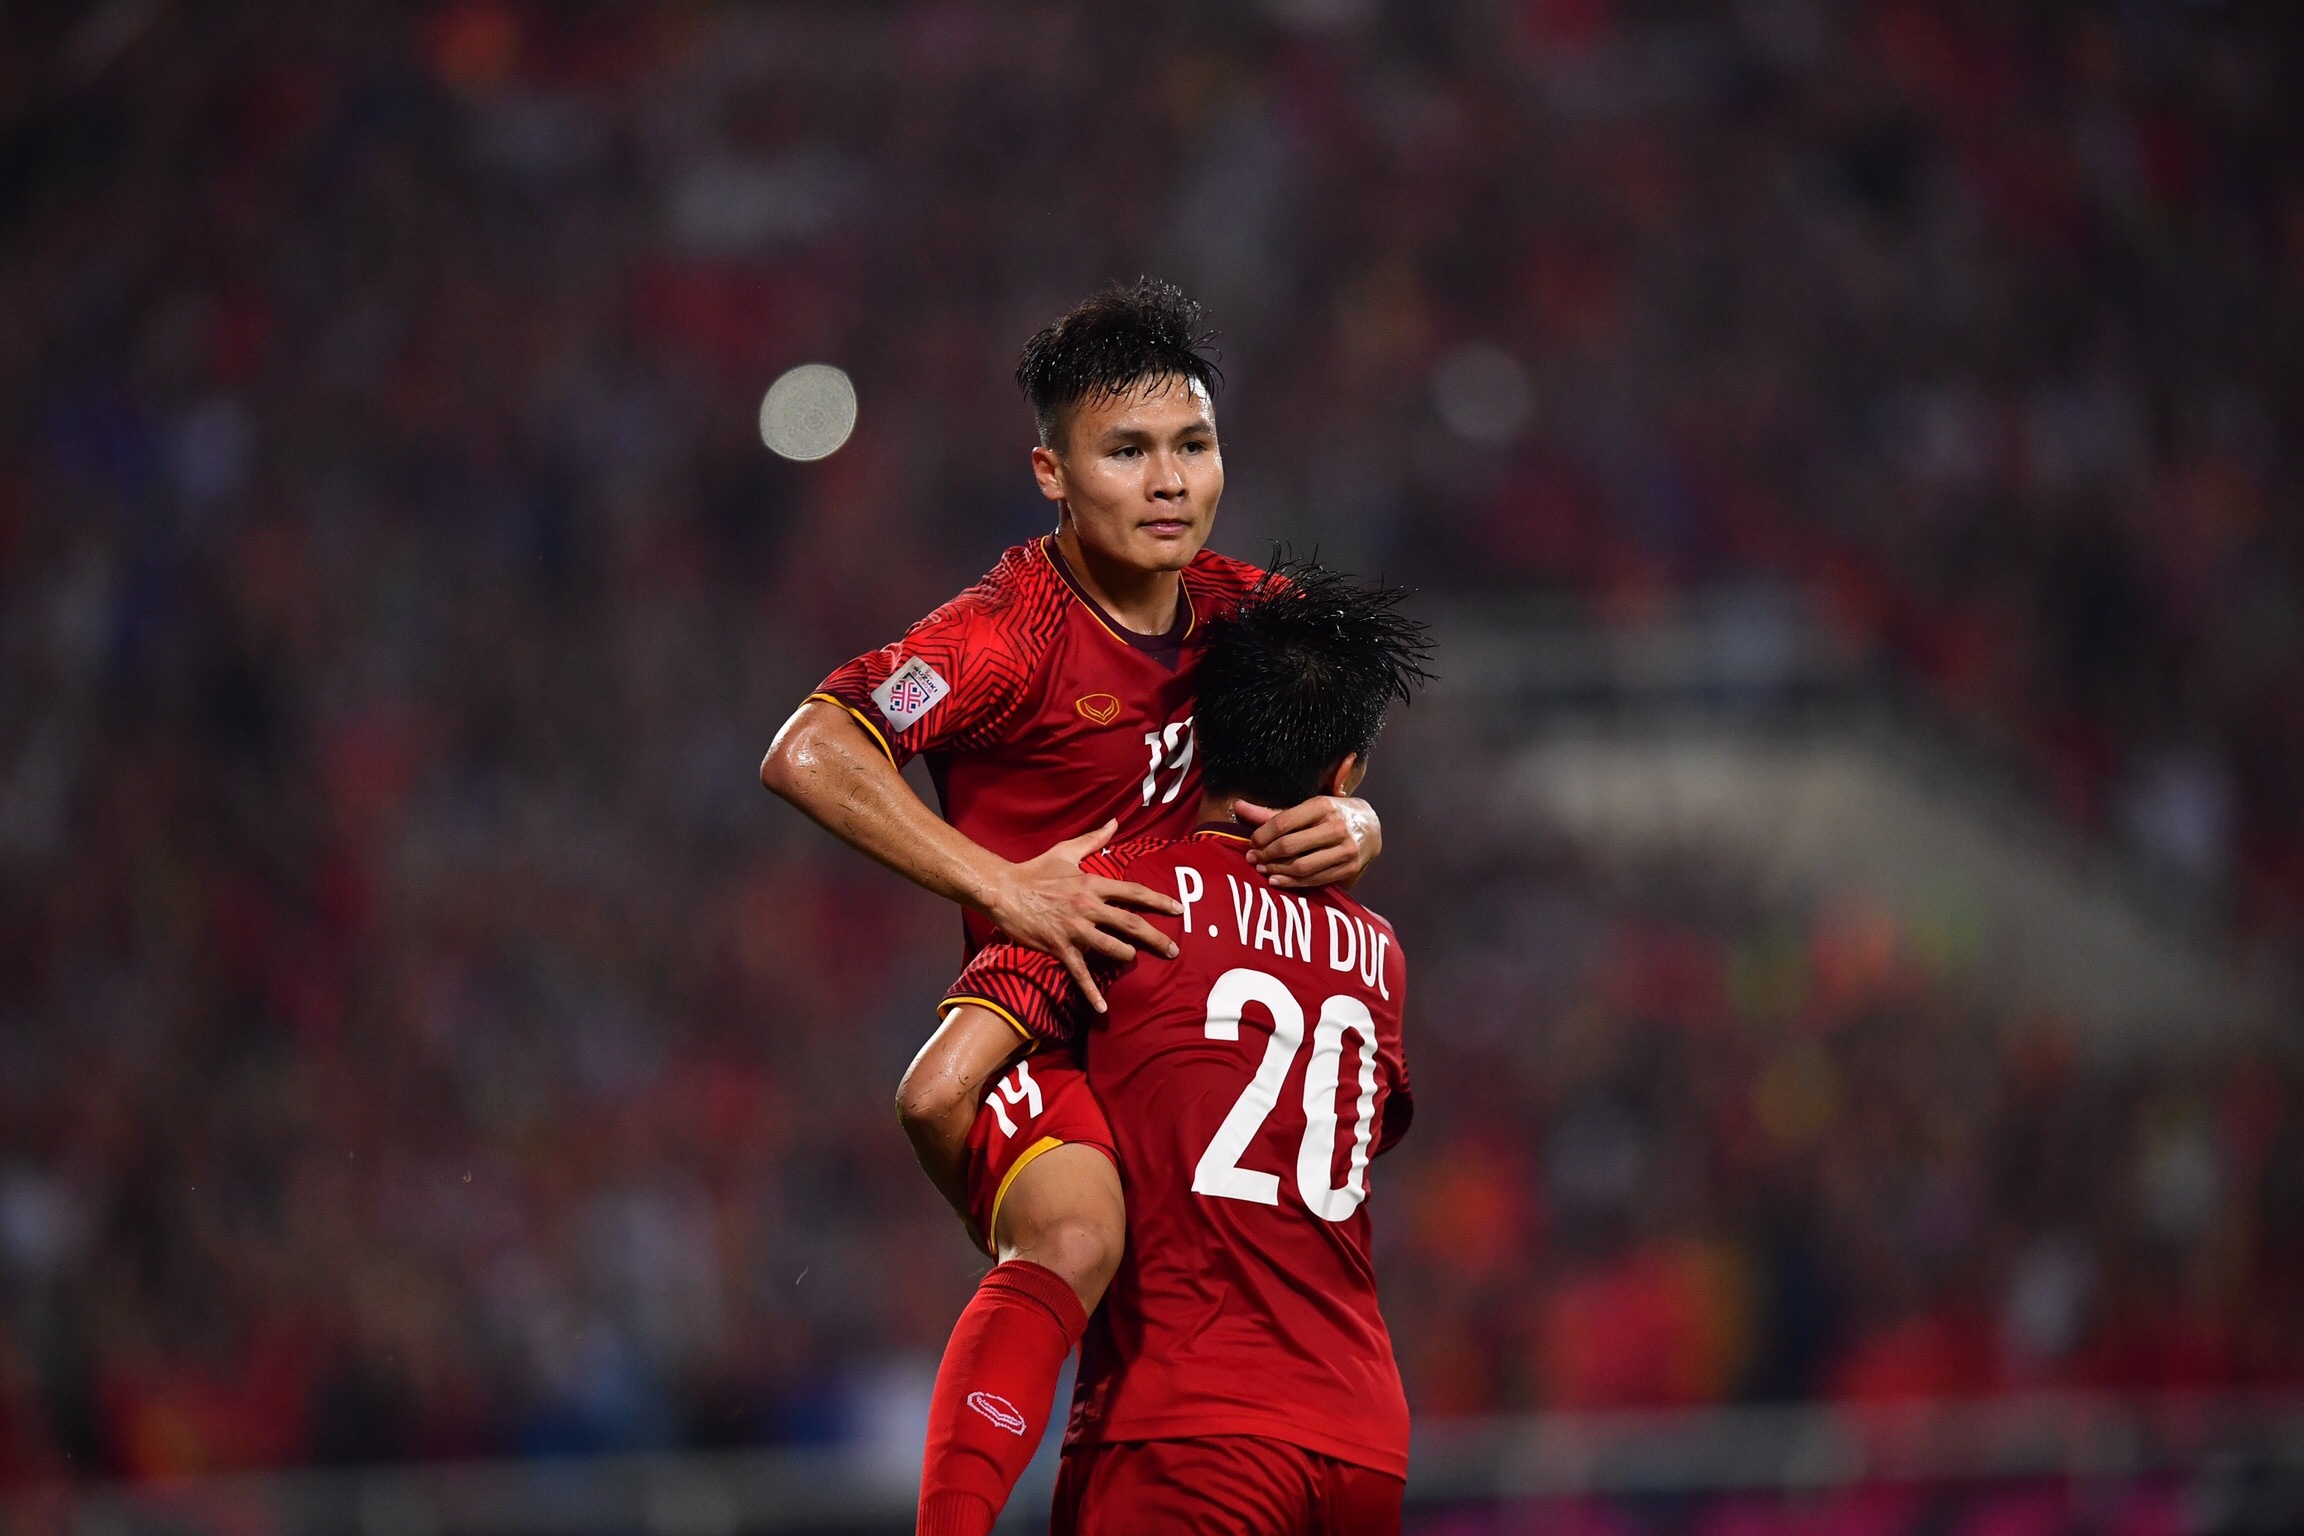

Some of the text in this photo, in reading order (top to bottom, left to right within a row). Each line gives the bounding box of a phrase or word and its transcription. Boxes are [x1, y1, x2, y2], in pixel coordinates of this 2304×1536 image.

[913, 666, 938, 693] SUZUKI
[1142, 716, 1194, 807] 19
[1175, 866, 1390, 1001] P. VAN DUC
[1191, 968, 1379, 1222] 20
